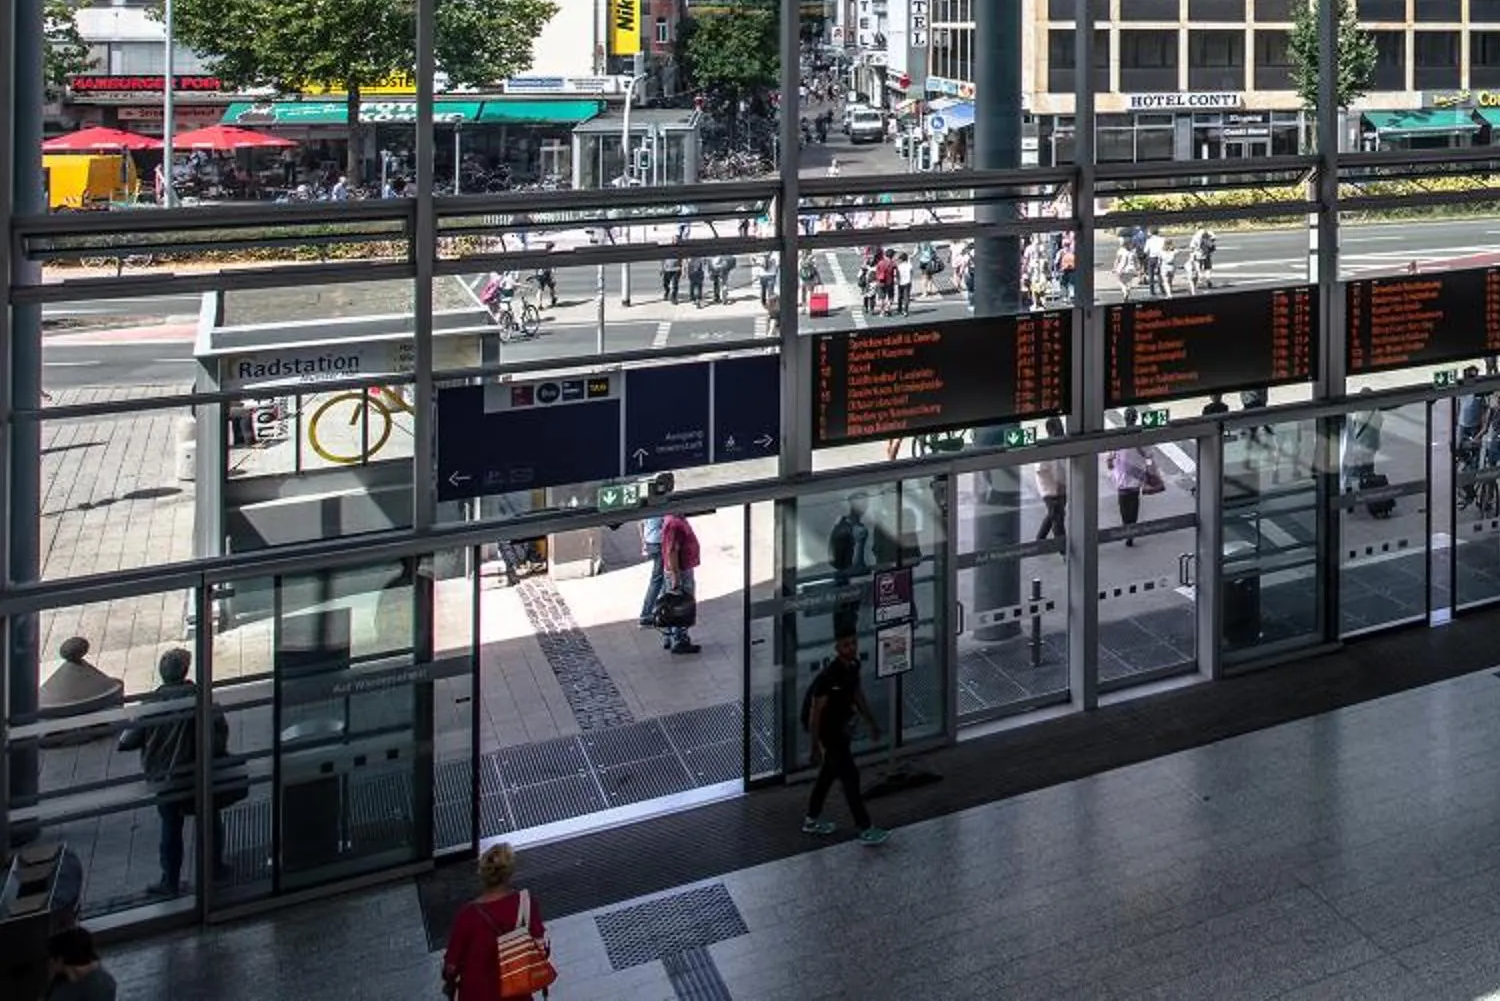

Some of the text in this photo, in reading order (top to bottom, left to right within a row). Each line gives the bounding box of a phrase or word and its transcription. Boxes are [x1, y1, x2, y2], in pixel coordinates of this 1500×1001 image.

[73, 78, 220, 90] HAMBURGE POIN
[1131, 94, 1237, 108] HOTEL CONTI
[239, 353, 360, 380] Radstation
